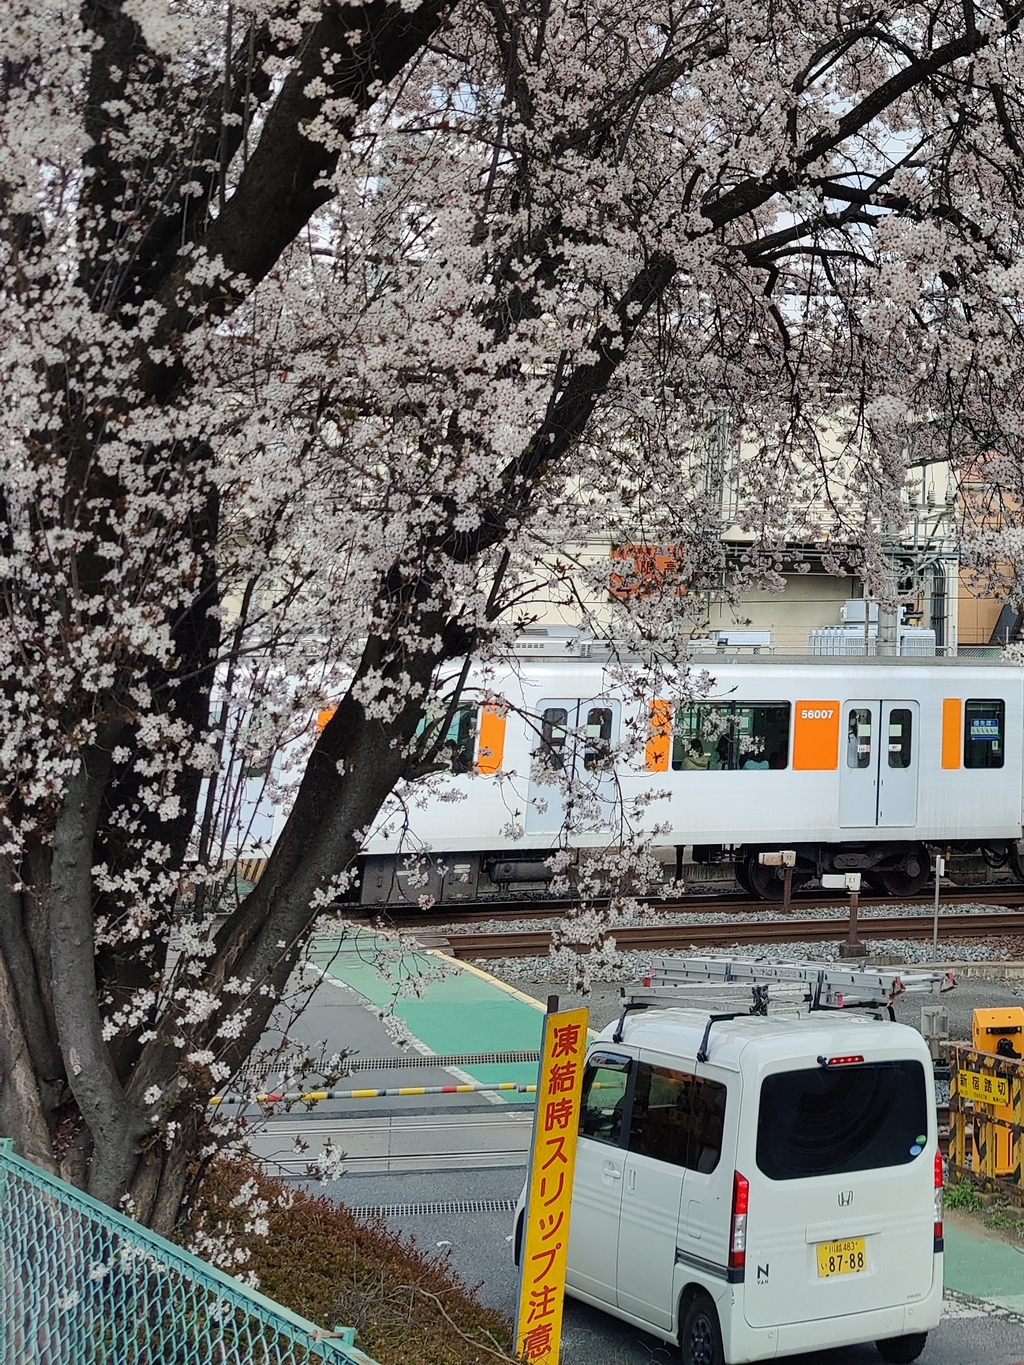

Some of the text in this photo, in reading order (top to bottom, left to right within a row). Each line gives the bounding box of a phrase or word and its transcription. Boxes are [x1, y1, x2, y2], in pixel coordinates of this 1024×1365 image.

[801, 709, 834, 719] 56007
[960, 1073, 1006, 1096] 新宿踏切
[526, 1023, 581, 1361] 凍結時スリップ注意
[843, 1241, 856, 1251] 483
[757, 1263, 770, 1279] N
[828, 1251, 865, 1273] 87-88
